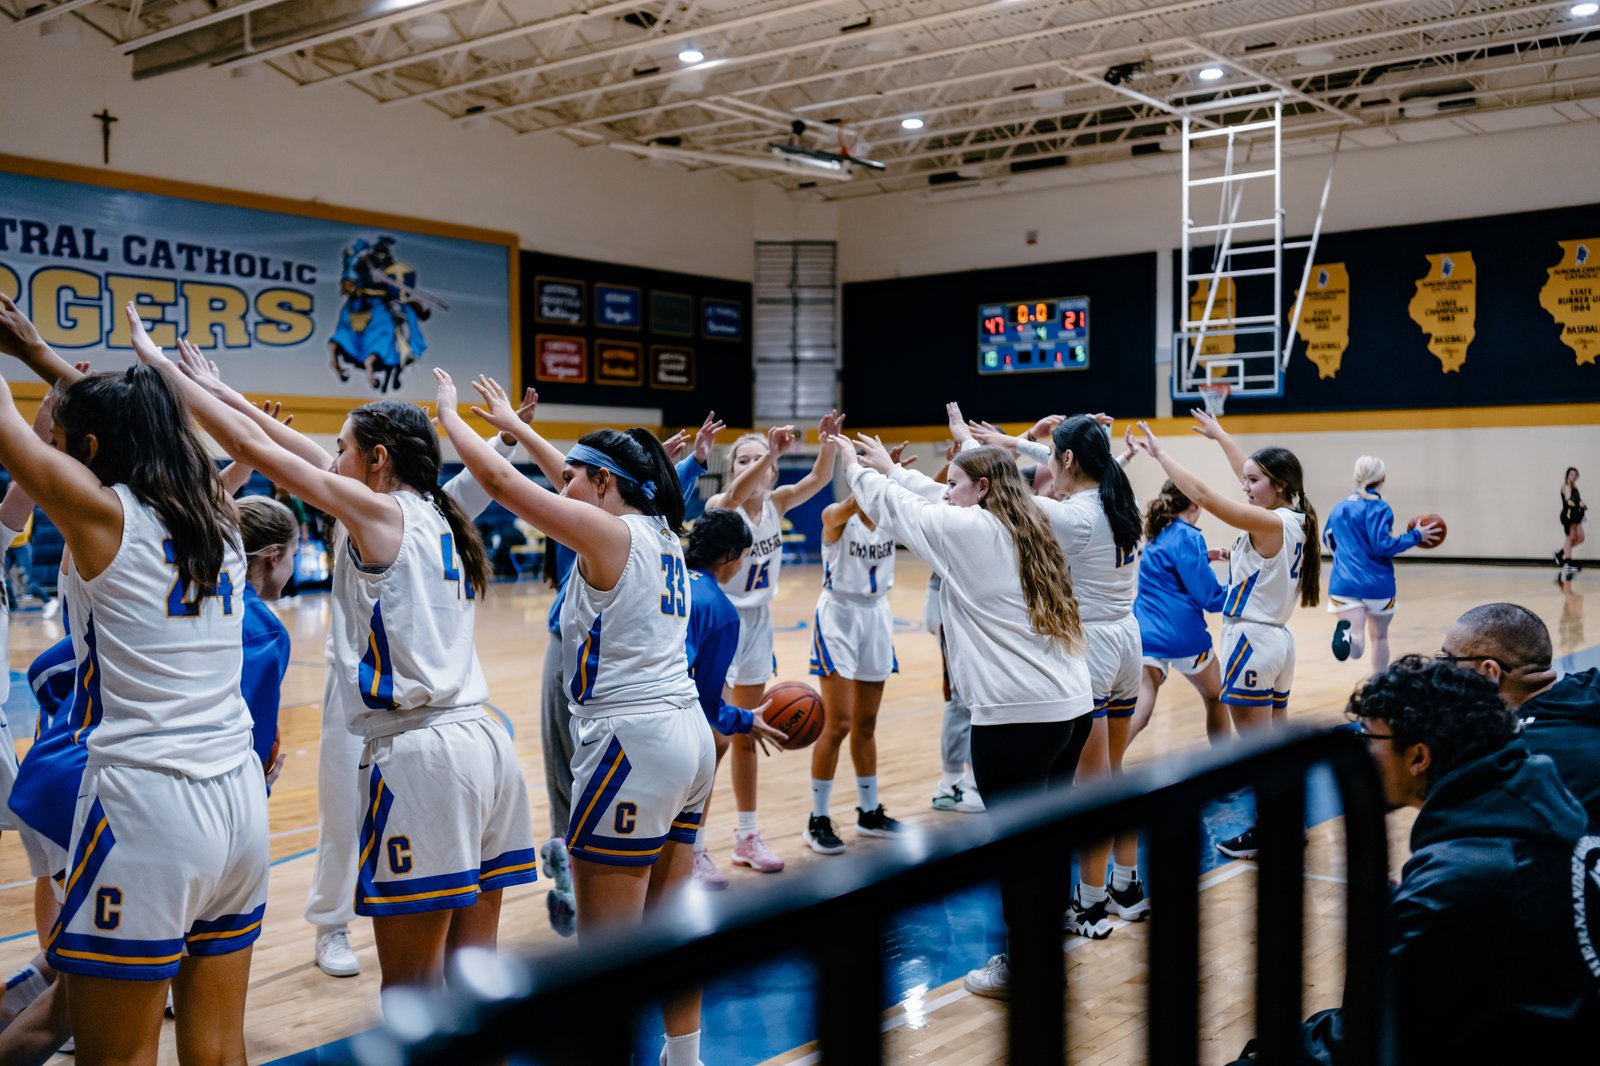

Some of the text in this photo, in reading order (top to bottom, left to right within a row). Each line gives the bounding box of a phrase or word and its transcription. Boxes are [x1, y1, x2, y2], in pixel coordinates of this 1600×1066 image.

[122, 234, 317, 285] CATHOLIC
[985, 316, 1005, 335] 47
[1017, 303, 1048, 324] 0.0
[1064, 310, 1085, 330] 21
[1567, 324, 1600, 335] BASEBAL
[849, 540, 893, 559] CHARGER
[660, 552, 686, 618] 33
[744, 558, 771, 592] 15
[869, 565, 878, 594] 1
[1244, 670, 1258, 688] C
[614, 802, 638, 835] C
[387, 834, 413, 875] C
[94, 885, 123, 932] C
